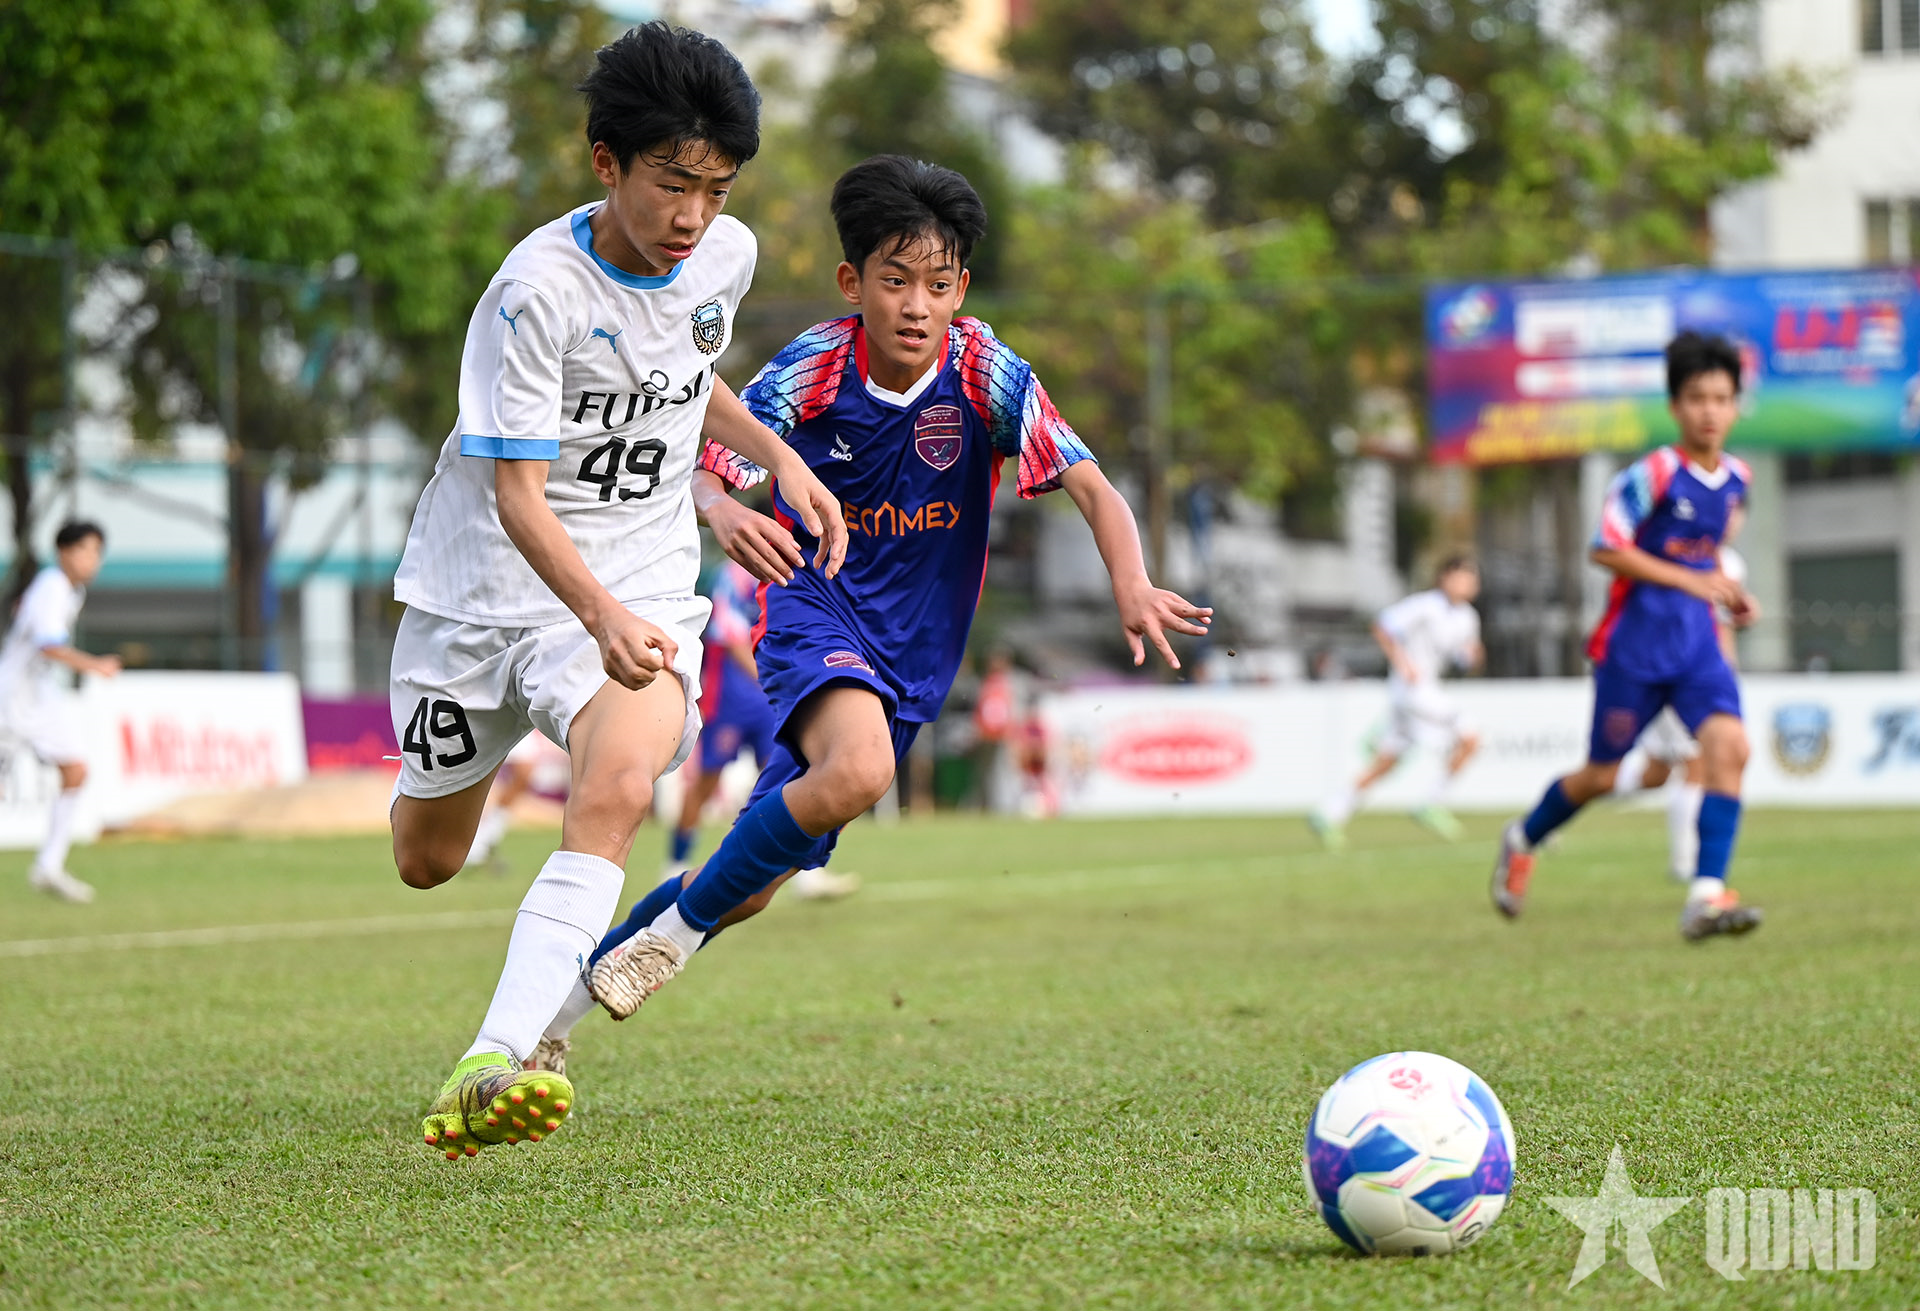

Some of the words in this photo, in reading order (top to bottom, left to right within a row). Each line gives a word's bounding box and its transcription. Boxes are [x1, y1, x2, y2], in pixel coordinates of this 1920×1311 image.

[577, 435, 667, 502] 49
[843, 501, 961, 537] ECAMEX
[402, 697, 478, 771] 49
